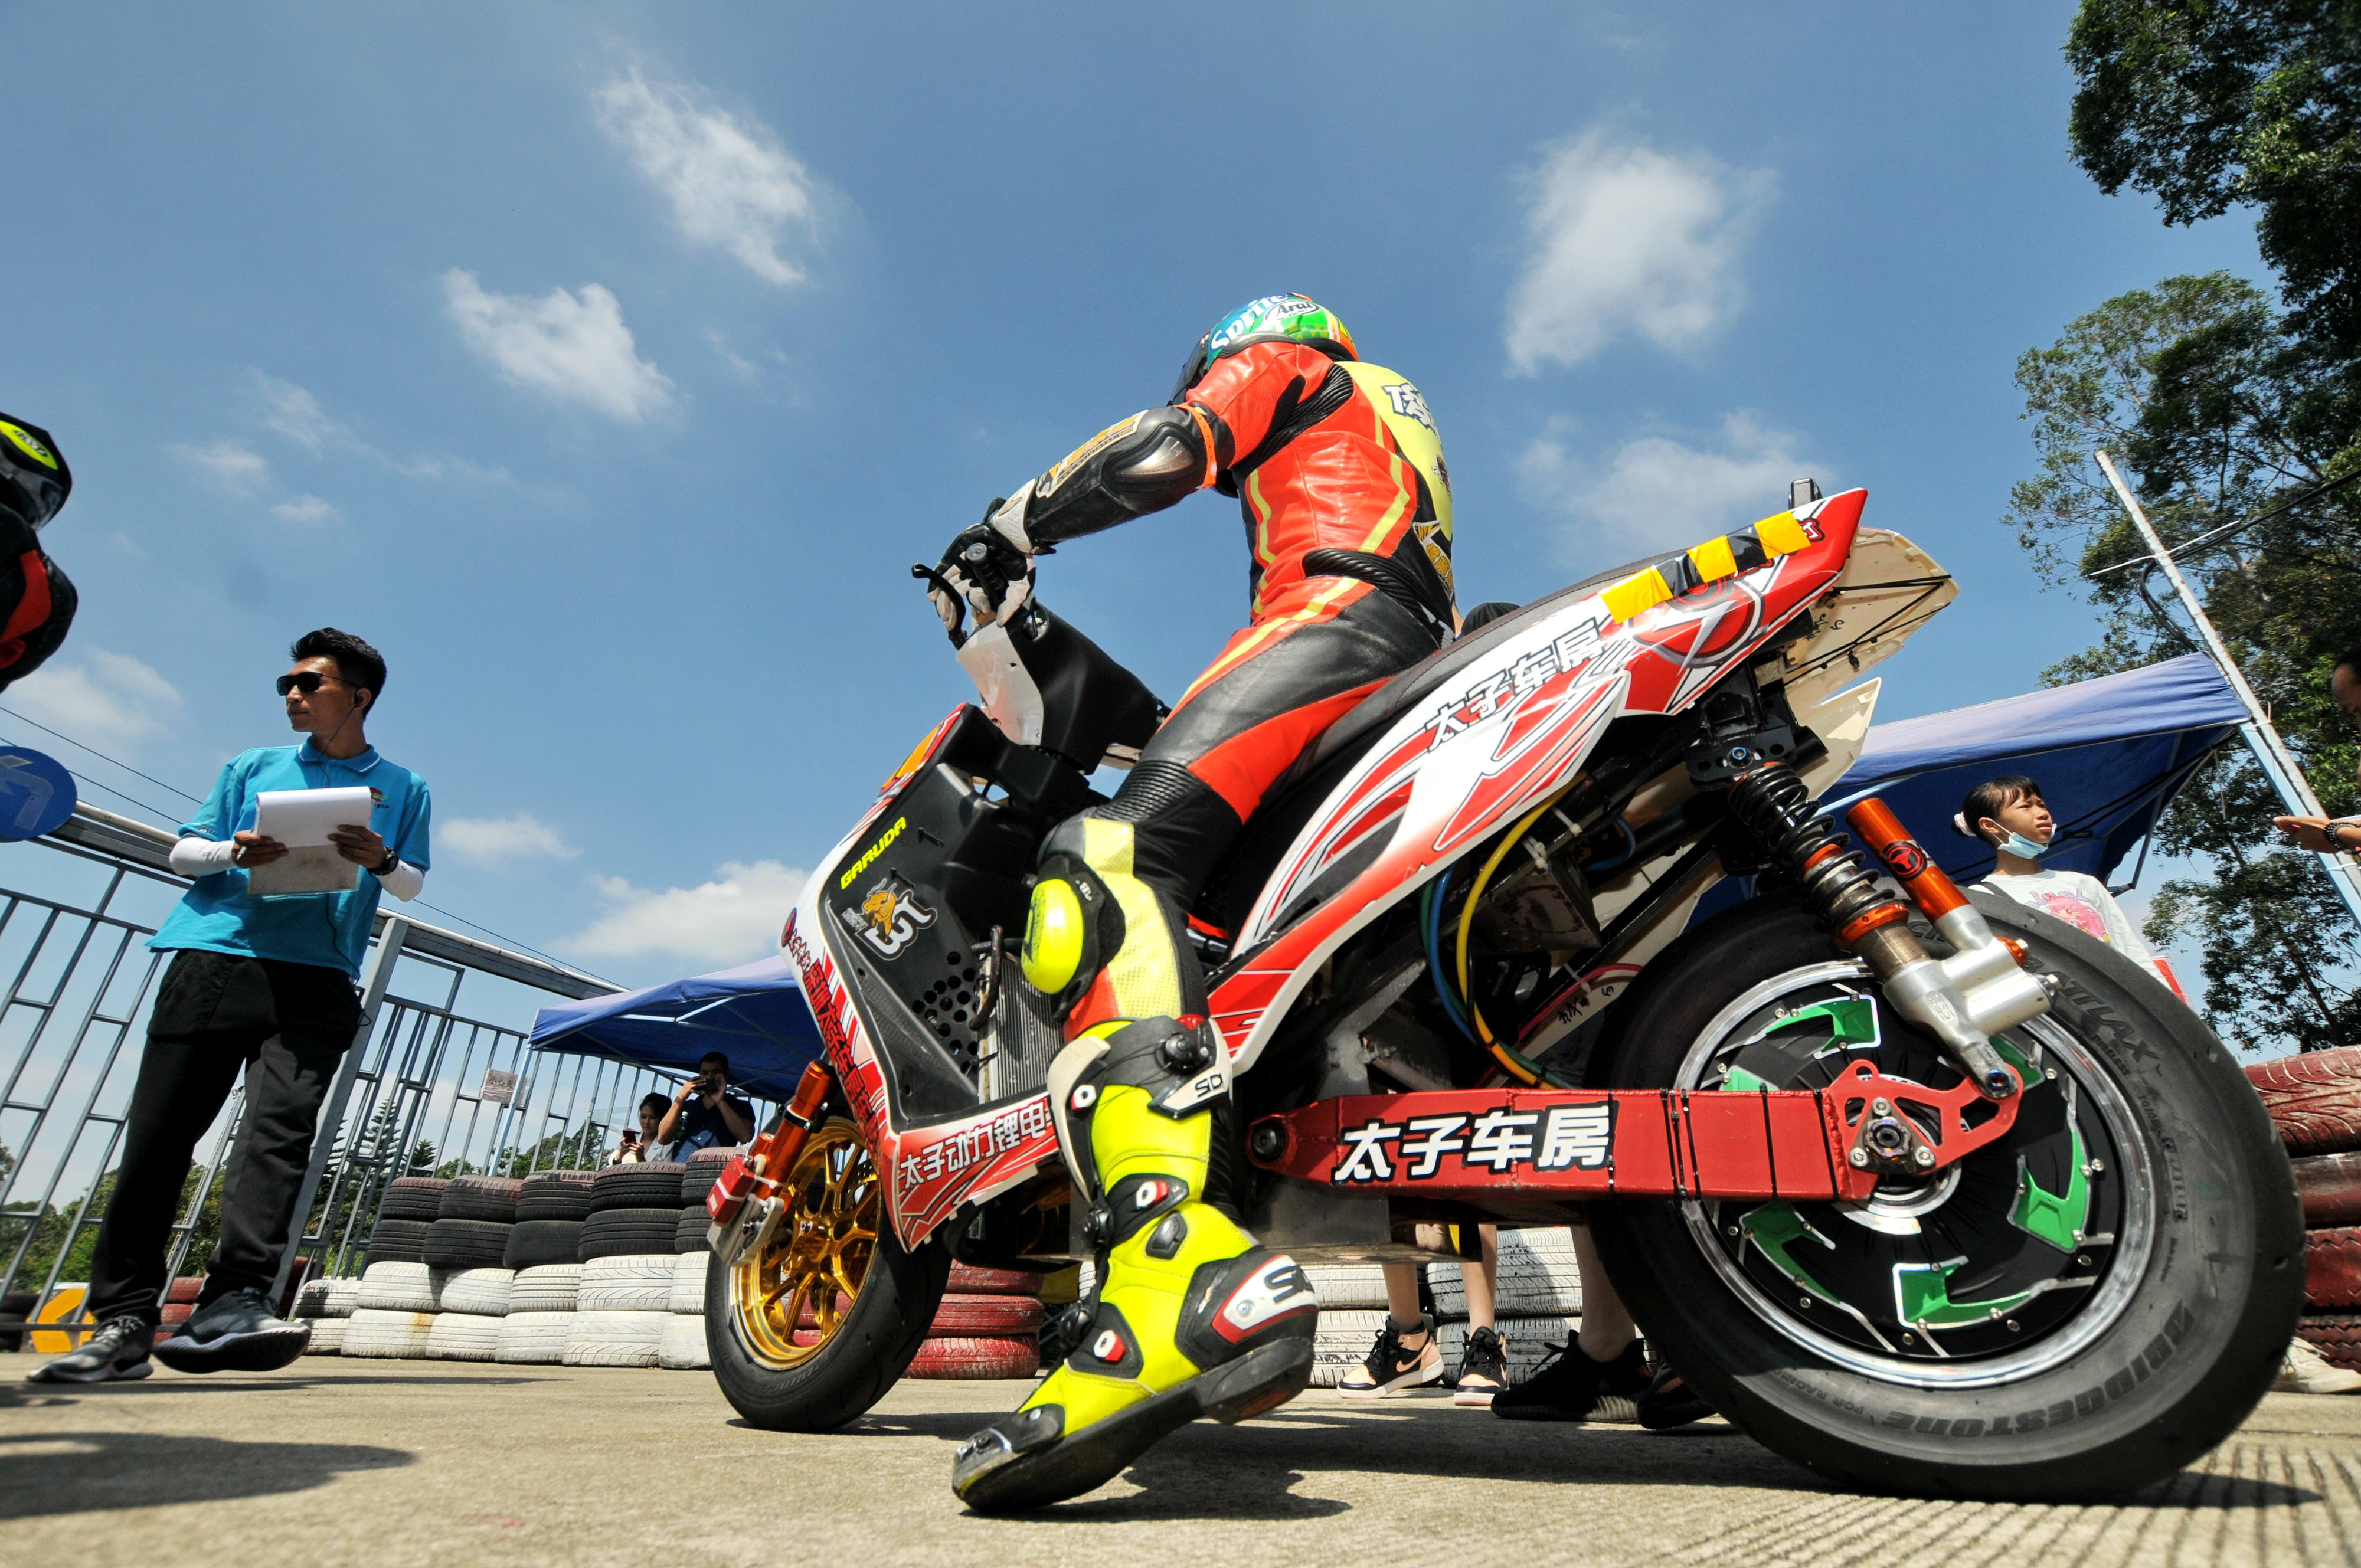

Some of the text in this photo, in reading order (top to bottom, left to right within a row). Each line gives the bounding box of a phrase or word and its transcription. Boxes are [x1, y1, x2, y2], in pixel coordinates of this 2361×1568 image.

[1275, 302, 1314, 319] Arai
[1423, 616, 1605, 754] 太子车房
[841, 816, 907, 890] GARUDA
[1333, 1104, 1610, 1182] 太子车房
[1882, 1301, 2195, 1438] BRIDGESTONE
